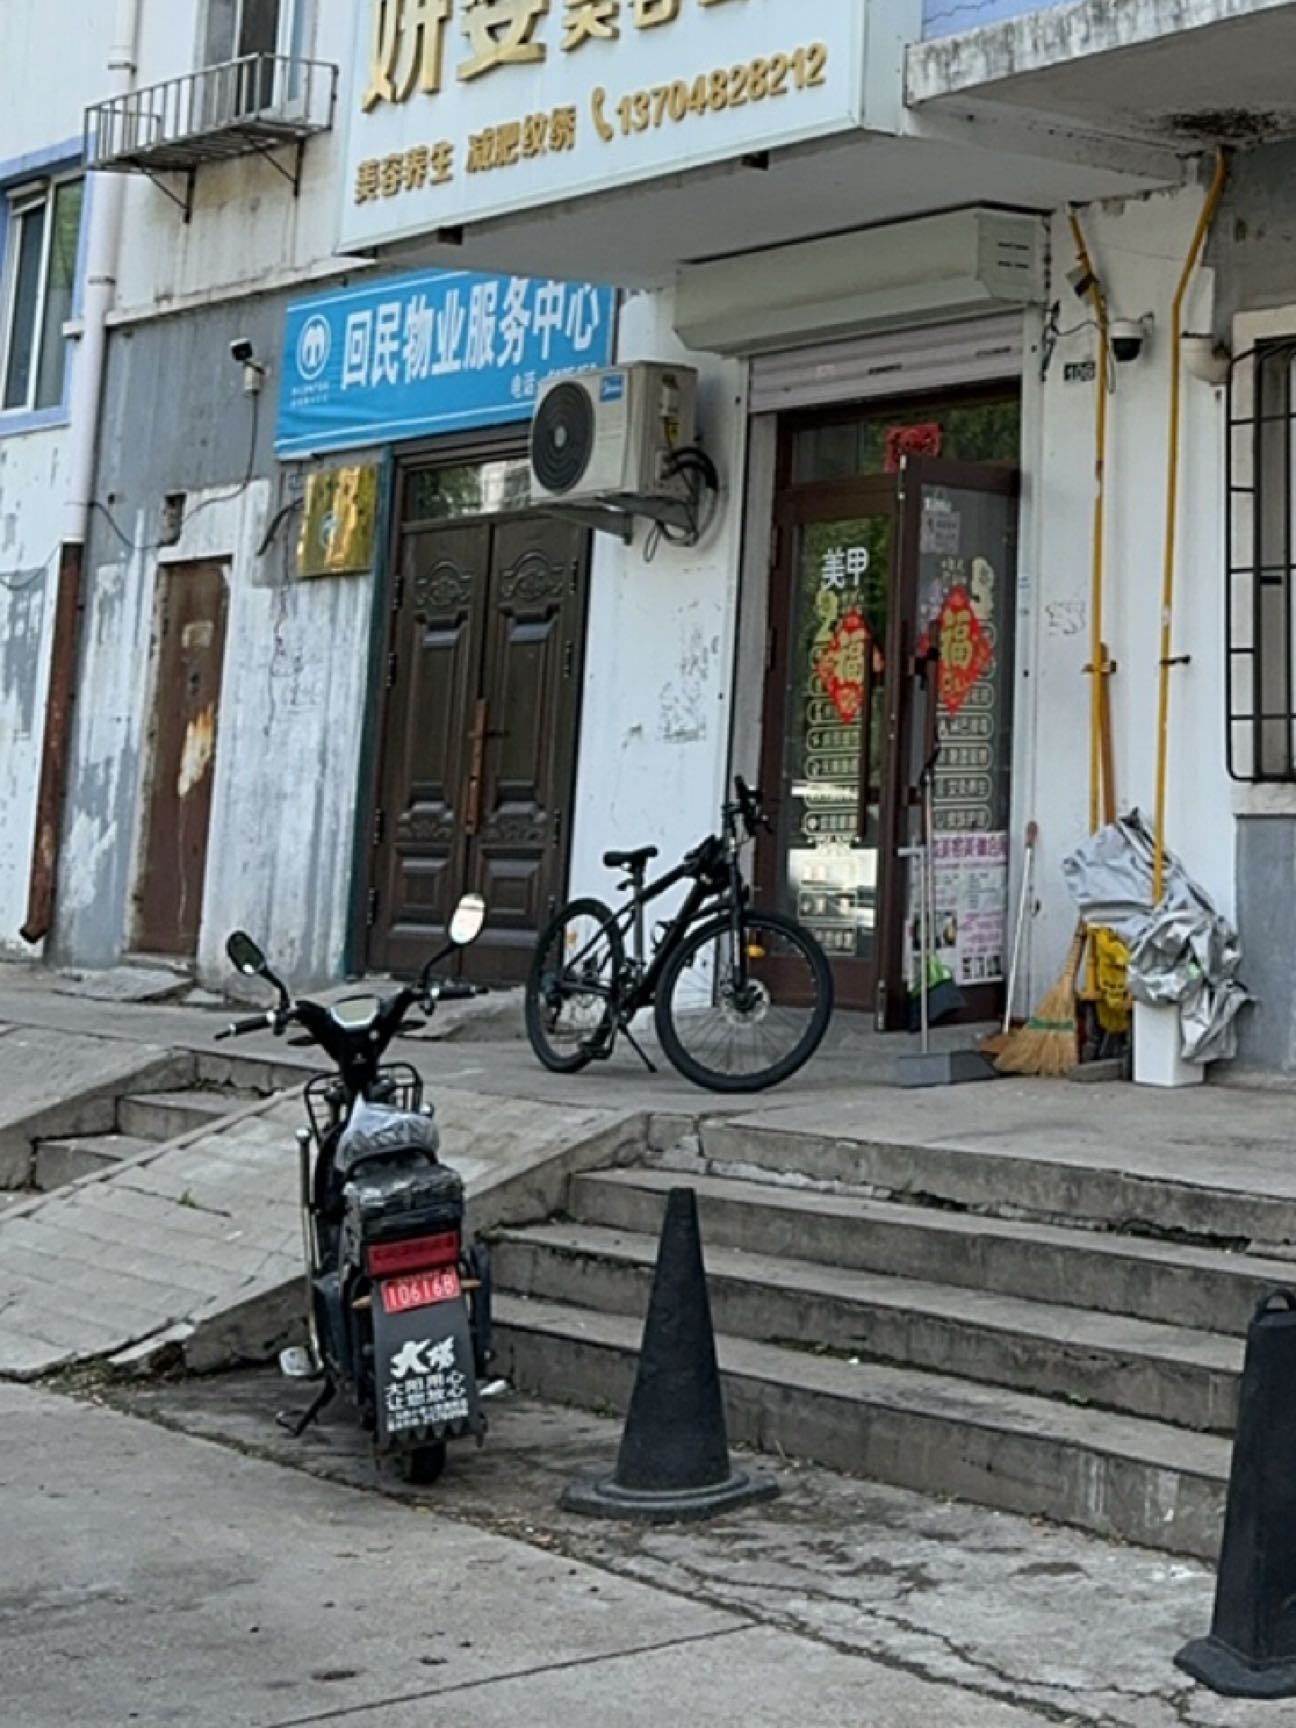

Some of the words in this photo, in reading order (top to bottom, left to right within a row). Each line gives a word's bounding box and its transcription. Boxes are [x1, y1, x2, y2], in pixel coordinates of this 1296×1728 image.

[354, 138, 455, 206] 美容养生
[616, 42, 828, 136] 13704828212
[340, 276, 600, 391] 回民物业服务中心
[821, 547, 868, 590] 美甲
